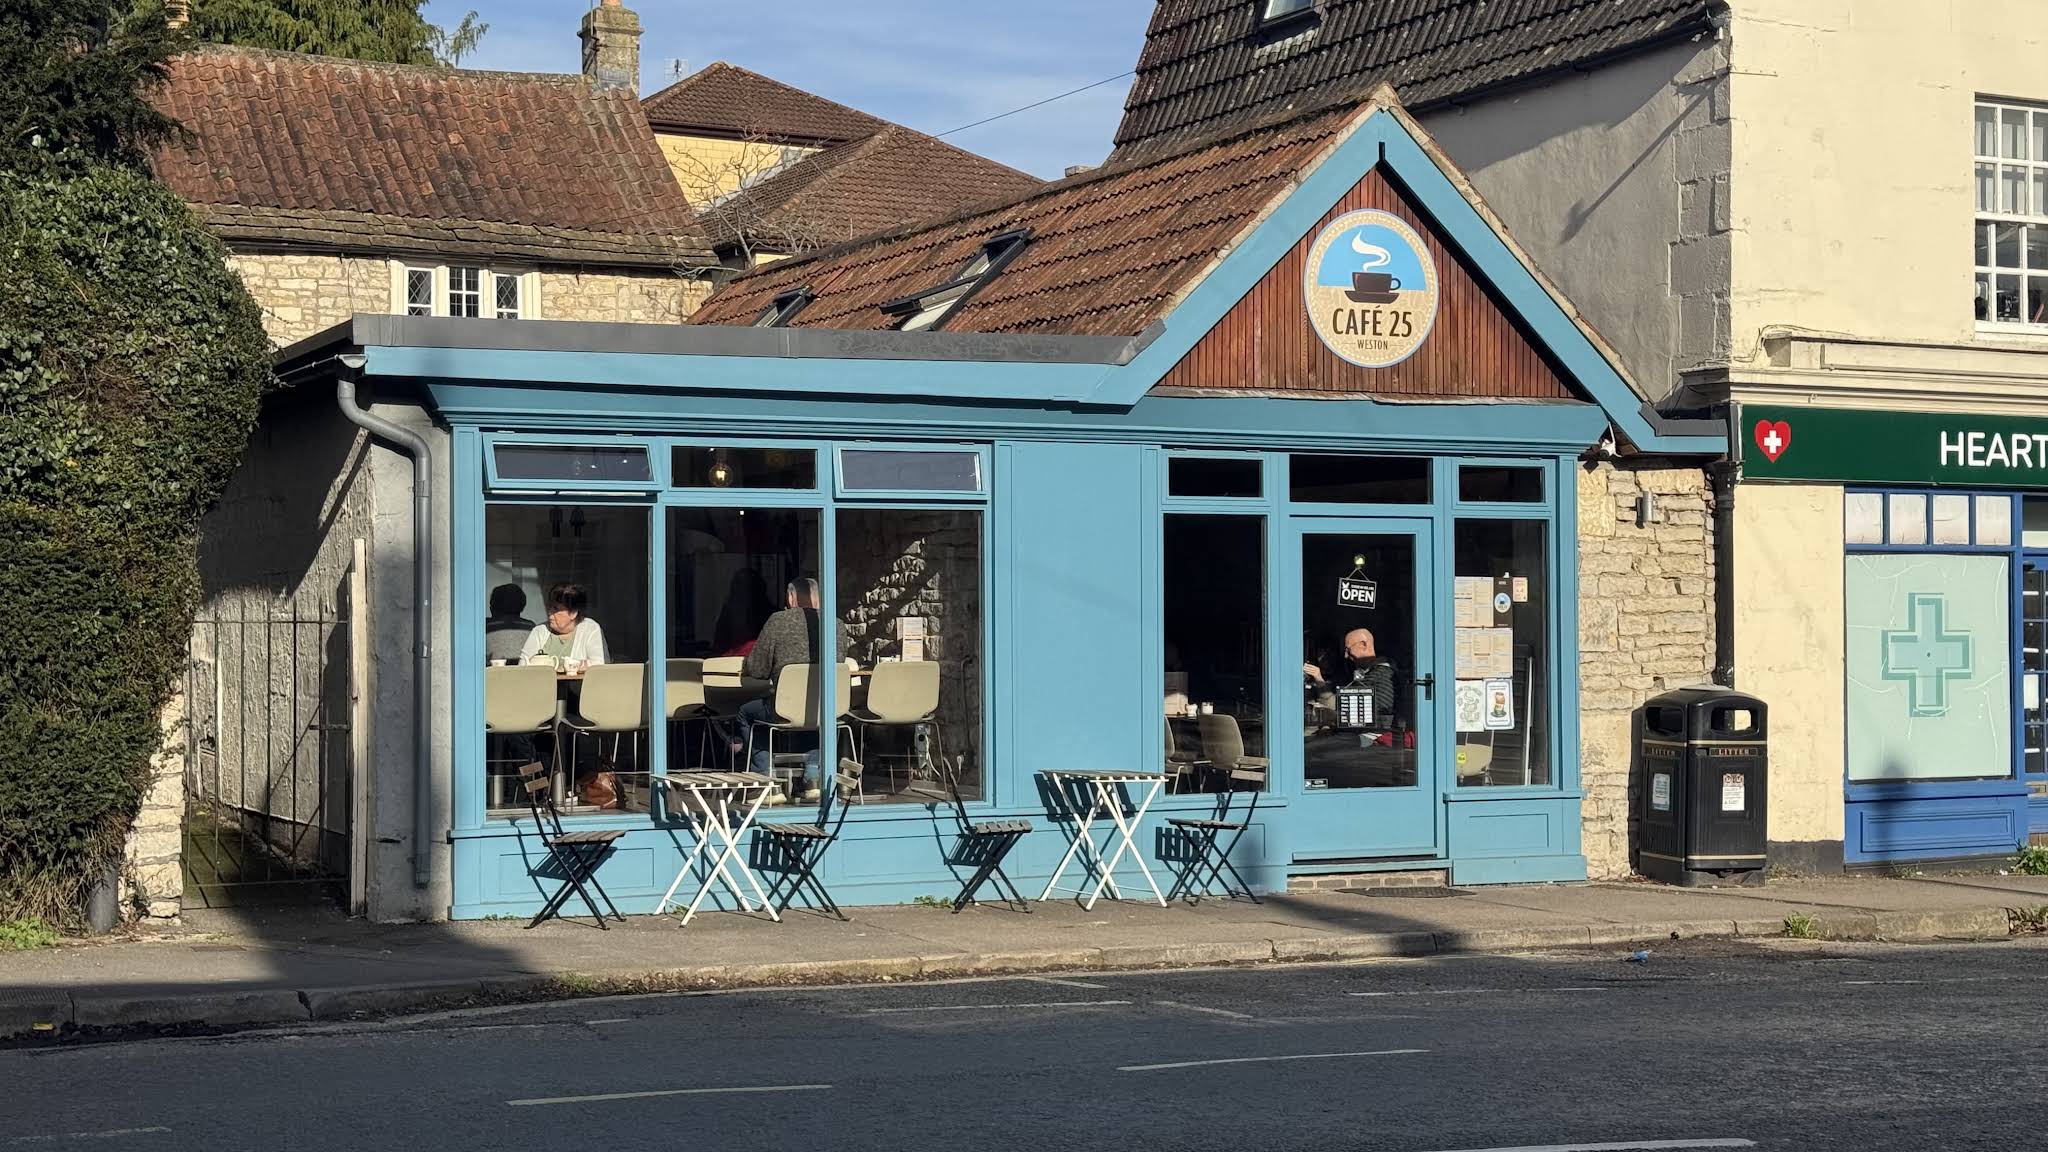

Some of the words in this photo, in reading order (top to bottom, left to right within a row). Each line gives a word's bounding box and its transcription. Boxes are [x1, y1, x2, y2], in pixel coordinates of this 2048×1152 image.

[1332, 305, 1383, 336] CAFÉ
[1389, 310, 1413, 338] 25
[1357, 339, 1389, 350] WESTON
[1940, 430, 2048, 469] HEART
[1341, 588, 1374, 603] OPEN
